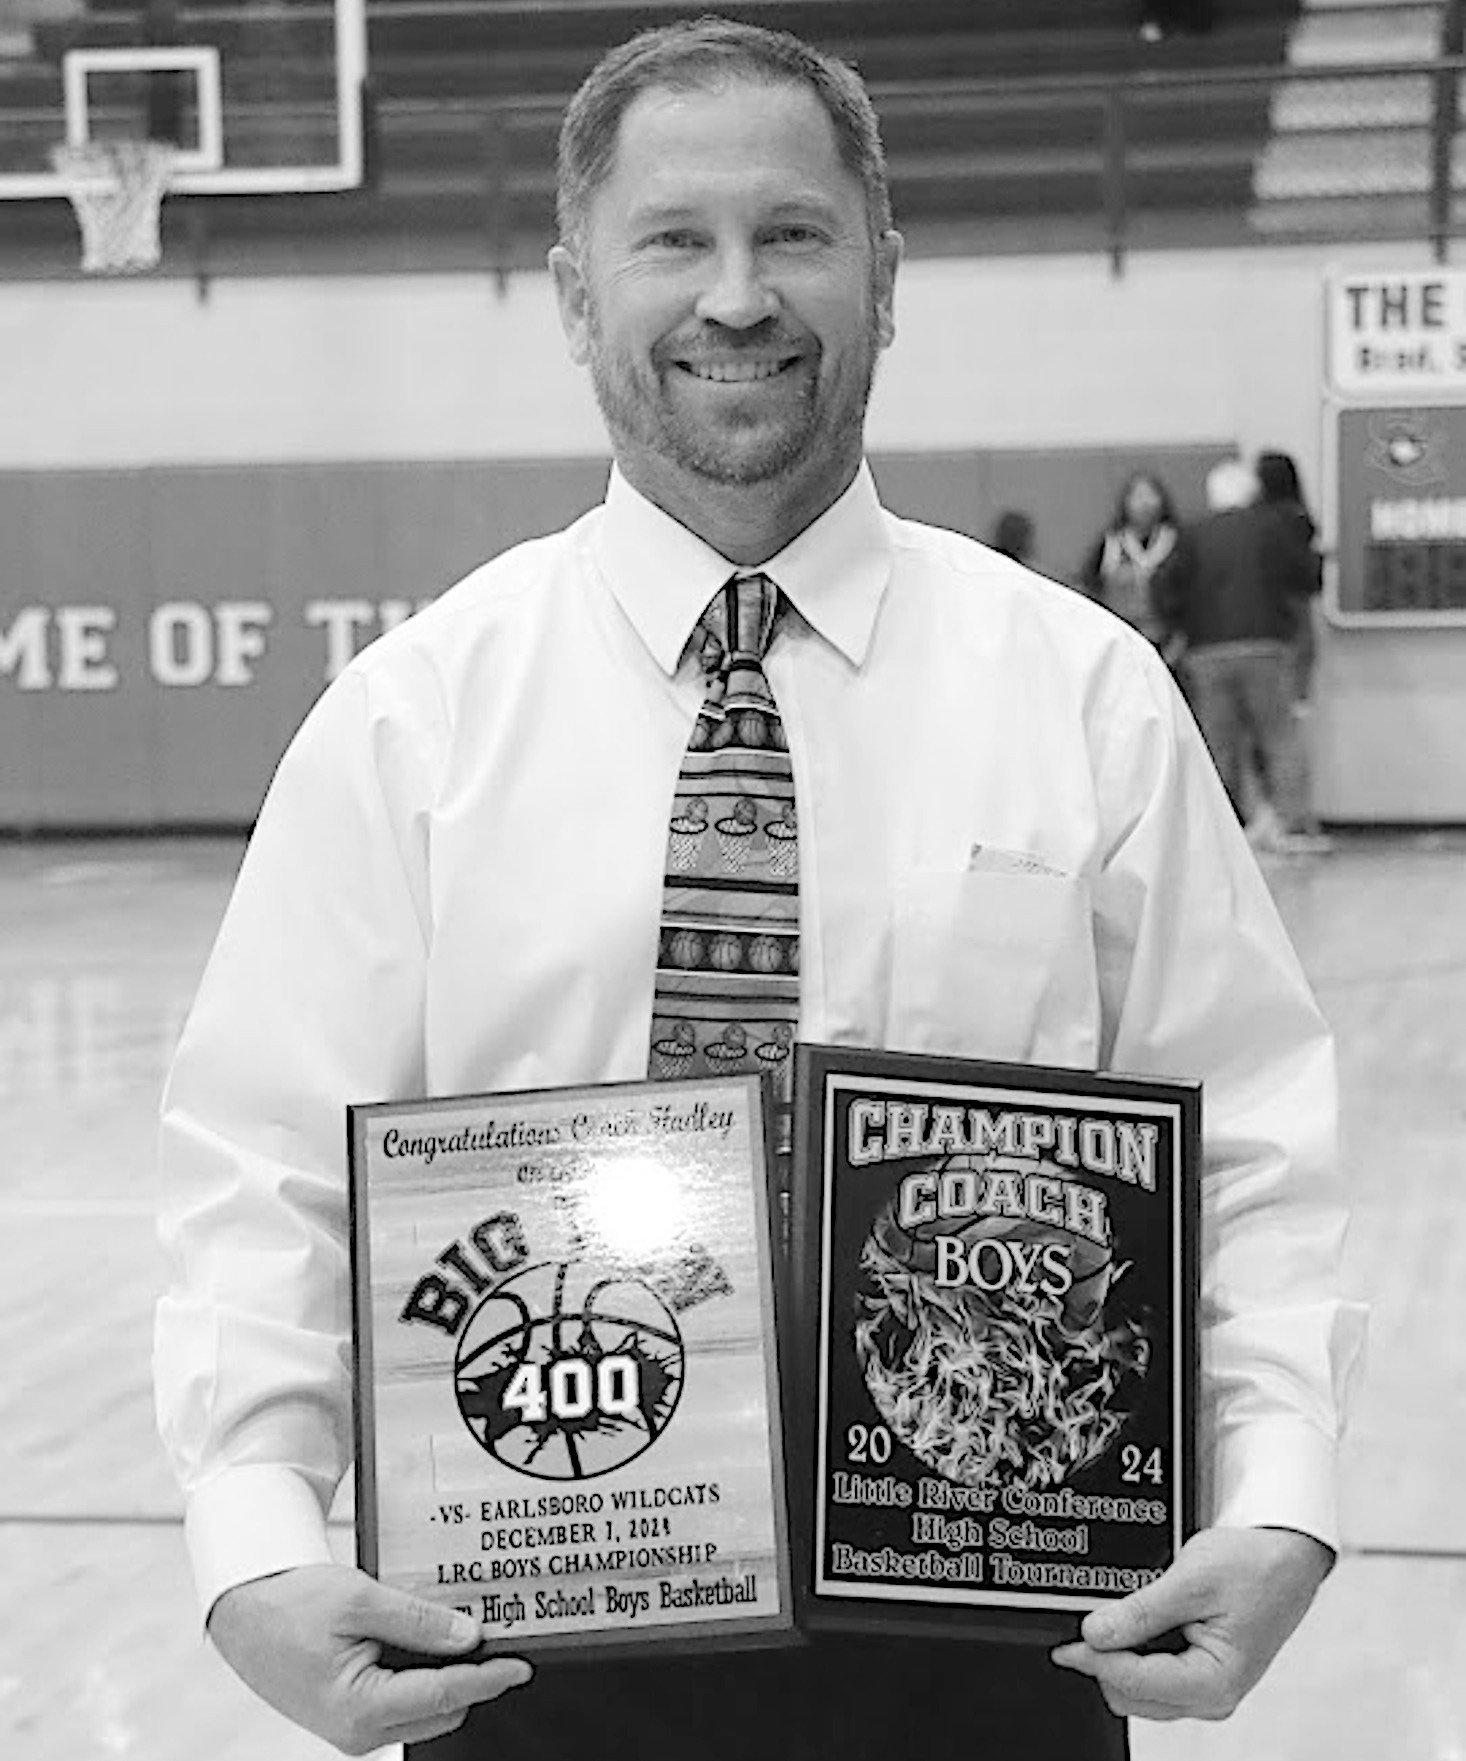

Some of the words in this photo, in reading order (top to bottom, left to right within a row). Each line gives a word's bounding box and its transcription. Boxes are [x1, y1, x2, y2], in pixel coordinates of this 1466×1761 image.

[1347, 284, 1445, 327] THE
[0, 605, 119, 690] ME
[149, 600, 274, 687] OF
[383, 1121, 561, 1165] Congratulations
[571, 1109, 638, 1144] Cach
[847, 1097, 1158, 1193] CHAMPION
[898, 1169, 1109, 1248] COACH
[400, 1209, 530, 1336] BIG
[935, 1235, 1073, 1296] BOYS
[502, 1354, 643, 1423] 400
[847, 1423, 892, 1463] 20
[1121, 1444, 1163, 1483] 24
[481, 1493, 604, 1522] EARLSBORO
[611, 1483, 720, 1510] WILDCATS
[832, 1471, 913, 1508] Little
[917, 1476, 997, 1513] River
[1001, 1483, 1168, 1524] Conference
[481, 1523, 596, 1551] DECEMBER
[606, 1520, 621, 1543] 1,
[910, 1510, 984, 1550] High
[988, 1517, 1091, 1555] School
[437, 1561, 482, 1584] LRC
[491, 1556, 542, 1579] BOYS
[549, 1542, 717, 1575] CHAMPIONSHIP
[832, 1542, 984, 1583] Basketball
[989, 1554, 1166, 1593] Tournamen
[481, 1594, 526, 1628] High
[534, 1587, 595, 1620] School
[605, 1582, 650, 1618] Boys
[659, 1574, 758, 1611] Basketball
